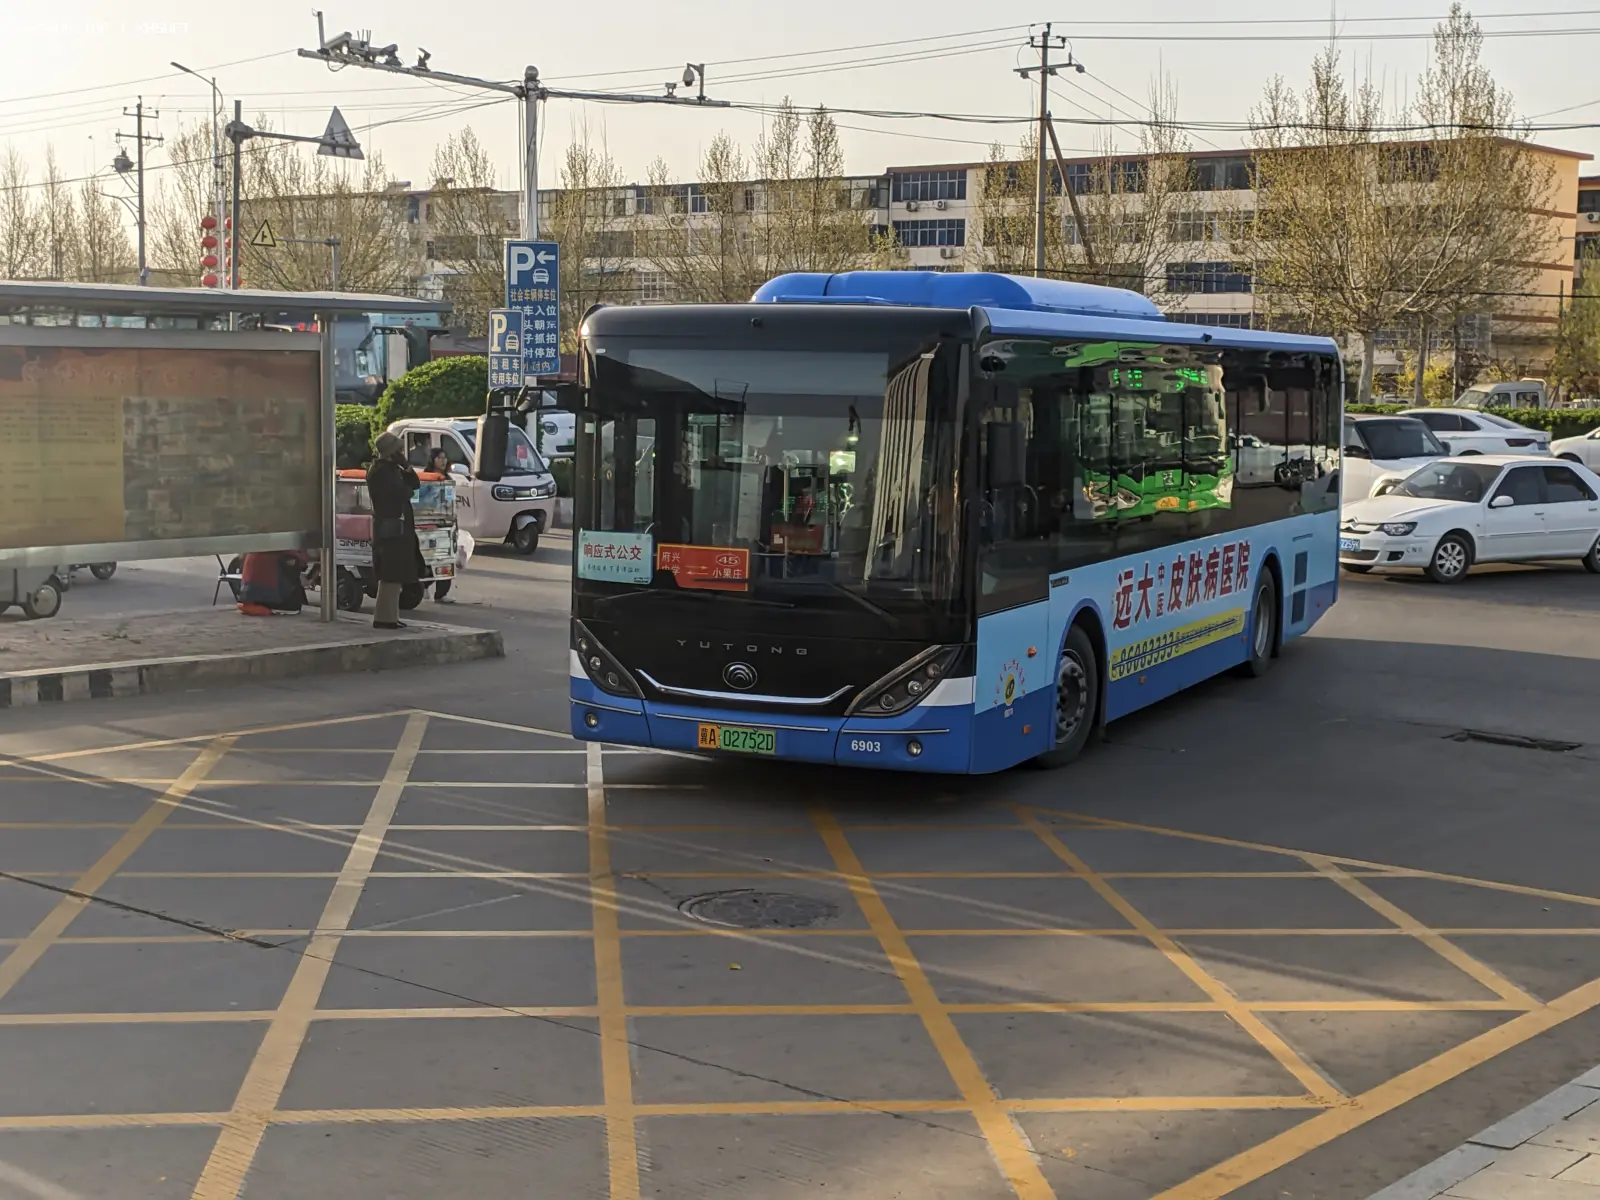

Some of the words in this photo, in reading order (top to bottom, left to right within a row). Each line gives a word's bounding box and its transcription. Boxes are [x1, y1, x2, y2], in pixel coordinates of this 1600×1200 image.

[510, 246, 535, 285] P
[510, 288, 556, 302] 社会车辆停车位
[524, 320, 557, 331] 头朝东
[491, 314, 508, 352] P
[524, 333, 556, 345] 子抓拍
[523, 347, 556, 359] 时停放
[491, 358, 520, 370] 出租车
[491, 372, 520, 385] 专用车位
[583, 543, 643, 562] 响应式公交
[718, 556, 739, 566] 45
[676, 639, 808, 656] YUTONG
[851, 739, 881, 753] 6903
